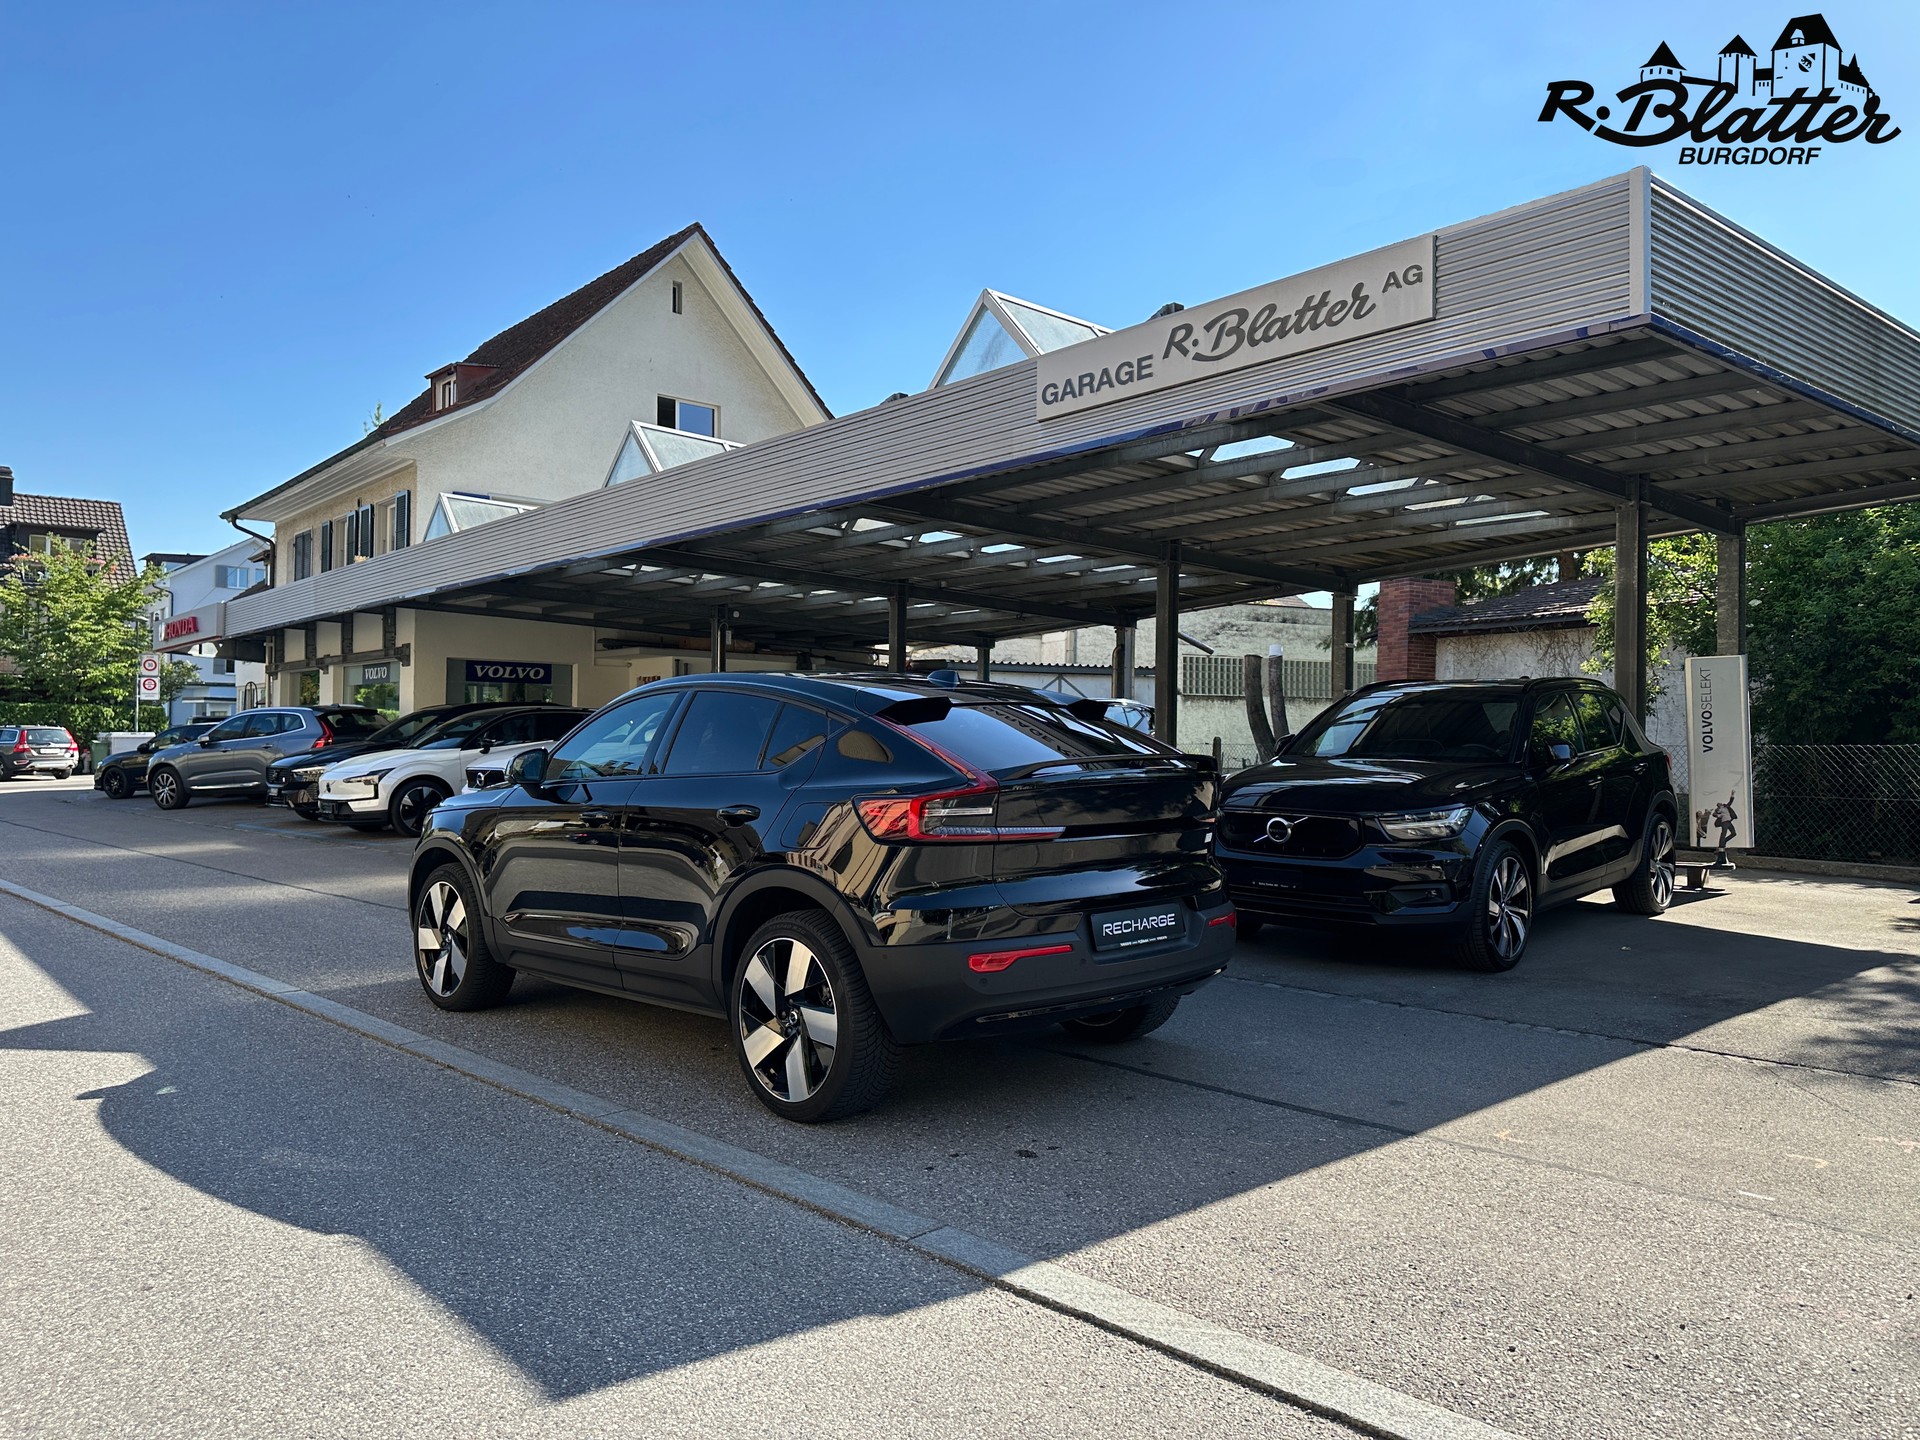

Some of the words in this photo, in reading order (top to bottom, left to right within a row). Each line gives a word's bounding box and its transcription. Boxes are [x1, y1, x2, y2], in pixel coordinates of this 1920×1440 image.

[1041, 354, 1153, 405] GARAGE
[1382, 264, 1423, 294] AG
[165, 616, 198, 640] HONDA
[365, 666, 387, 679] VOLVO
[474, 664, 545, 680] VOLVO
[1102, 913, 1176, 937] RECHARGE
